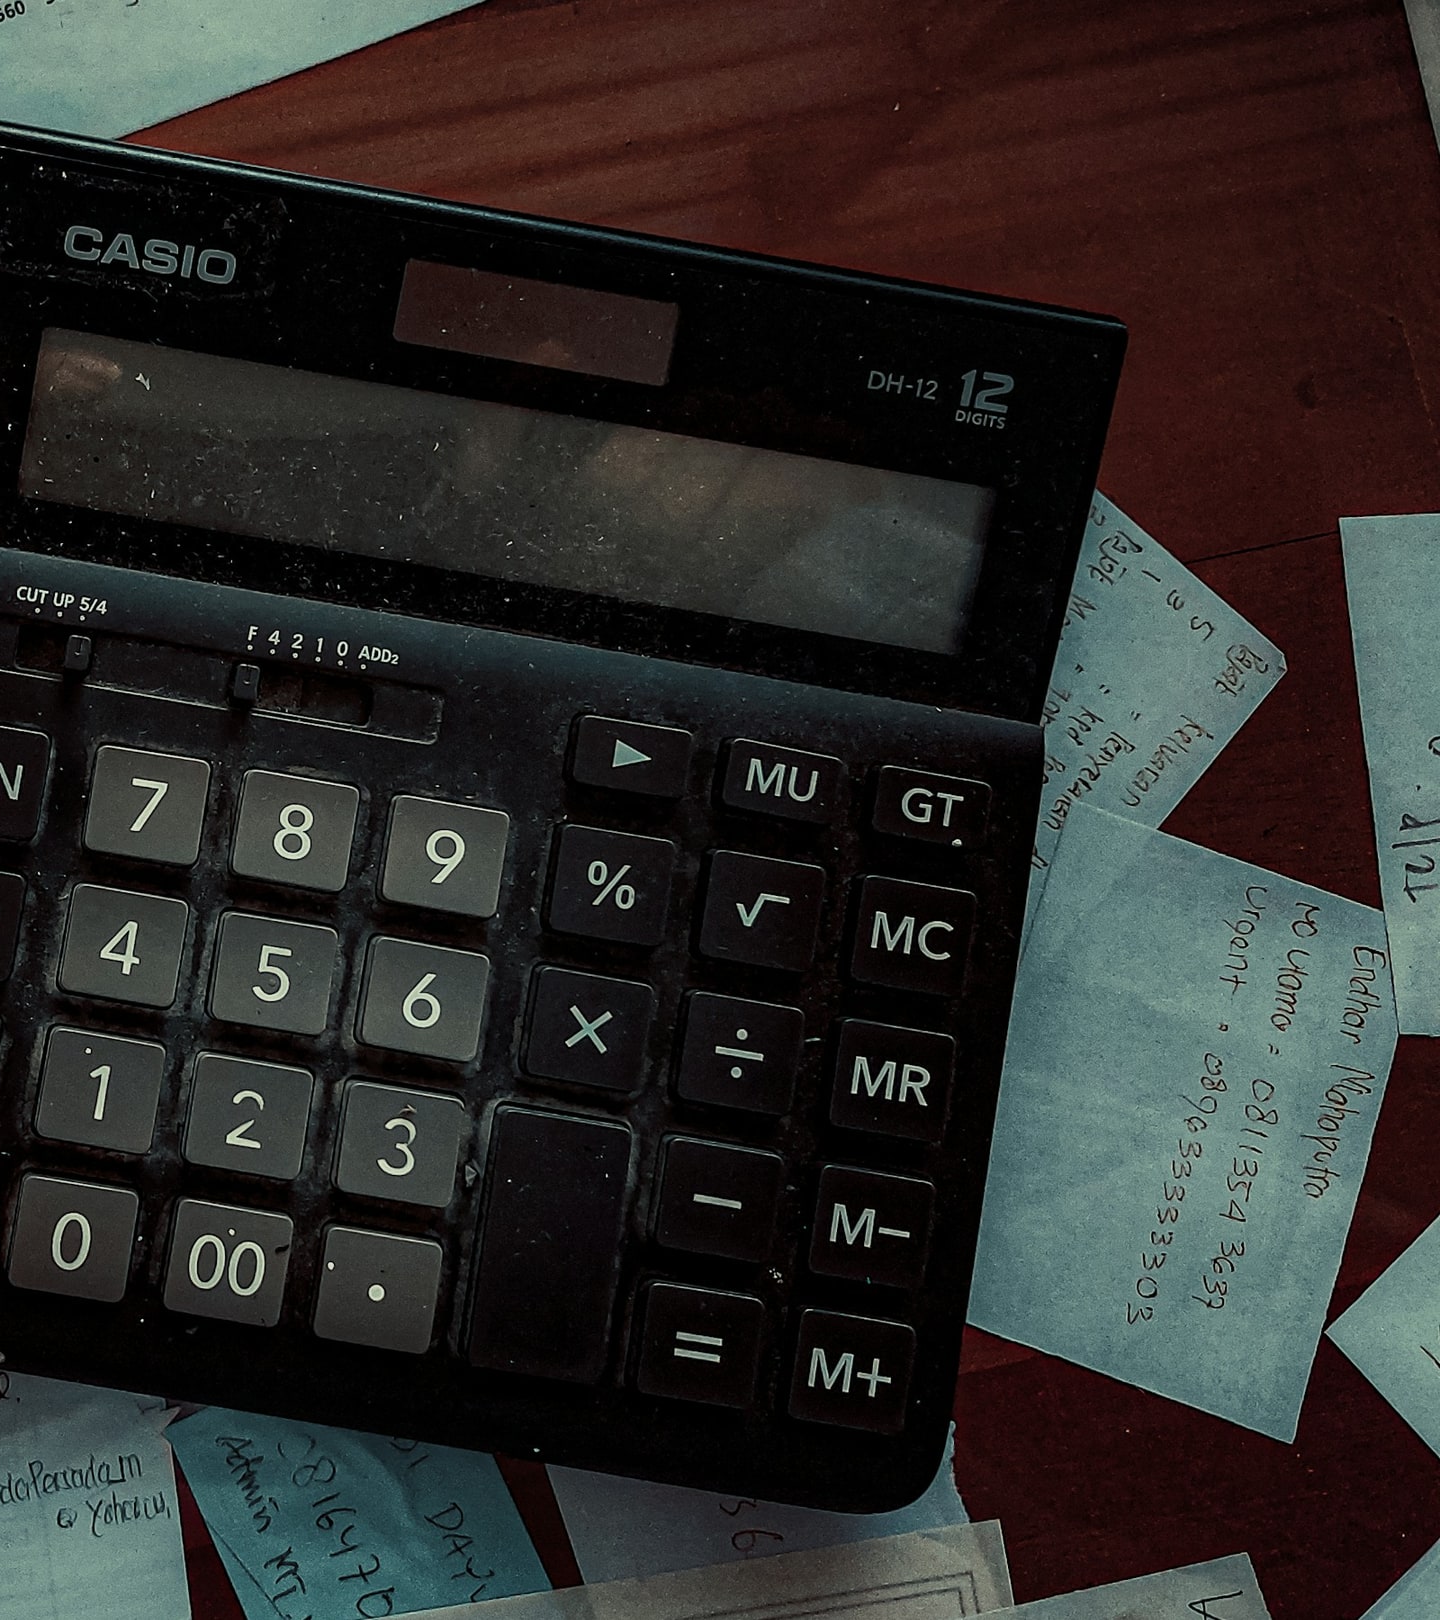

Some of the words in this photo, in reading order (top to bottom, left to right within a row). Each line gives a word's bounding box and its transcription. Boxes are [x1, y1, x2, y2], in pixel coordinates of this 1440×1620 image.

[64, 225, 237, 284] CASIO
[867, 370, 939, 400] DH-12
[960, 369, 1015, 414] 12
[955, 409, 1007, 430] DIGITS
[16, 585, 50, 605] CUT
[52, 591, 75, 609] UP
[79, 596, 108, 615] 5/4
[247, 626, 258, 642] F
[267, 629, 281, 646] 4
[291, 633, 303, 649] 2
[316, 637, 323, 654] 1
[336, 640, 348, 657] 0
[131, 777, 169, 833] 7
[745, 758, 819, 802] MU
[901, 787, 965, 828] GT
[272, 803, 315, 860] 8
[424, 828, 466, 884] 9
[587, 860, 636, 911] %
[99, 920, 140, 976] 4
[870, 911, 955, 961] MC
[251, 944, 293, 1002] 5
[402, 972, 441, 1029] 6
[89, 1064, 112, 1122] 1
[851, 1055, 931, 1107] MR
[225, 1089, 265, 1150] 2
[376, 1115, 417, 1177] 3
[52, 1211, 93, 1272] 0
[829, 1203, 910, 1249] M-
[188, 1233, 267, 1298] 00
[808, 1347, 892, 1398] M+
